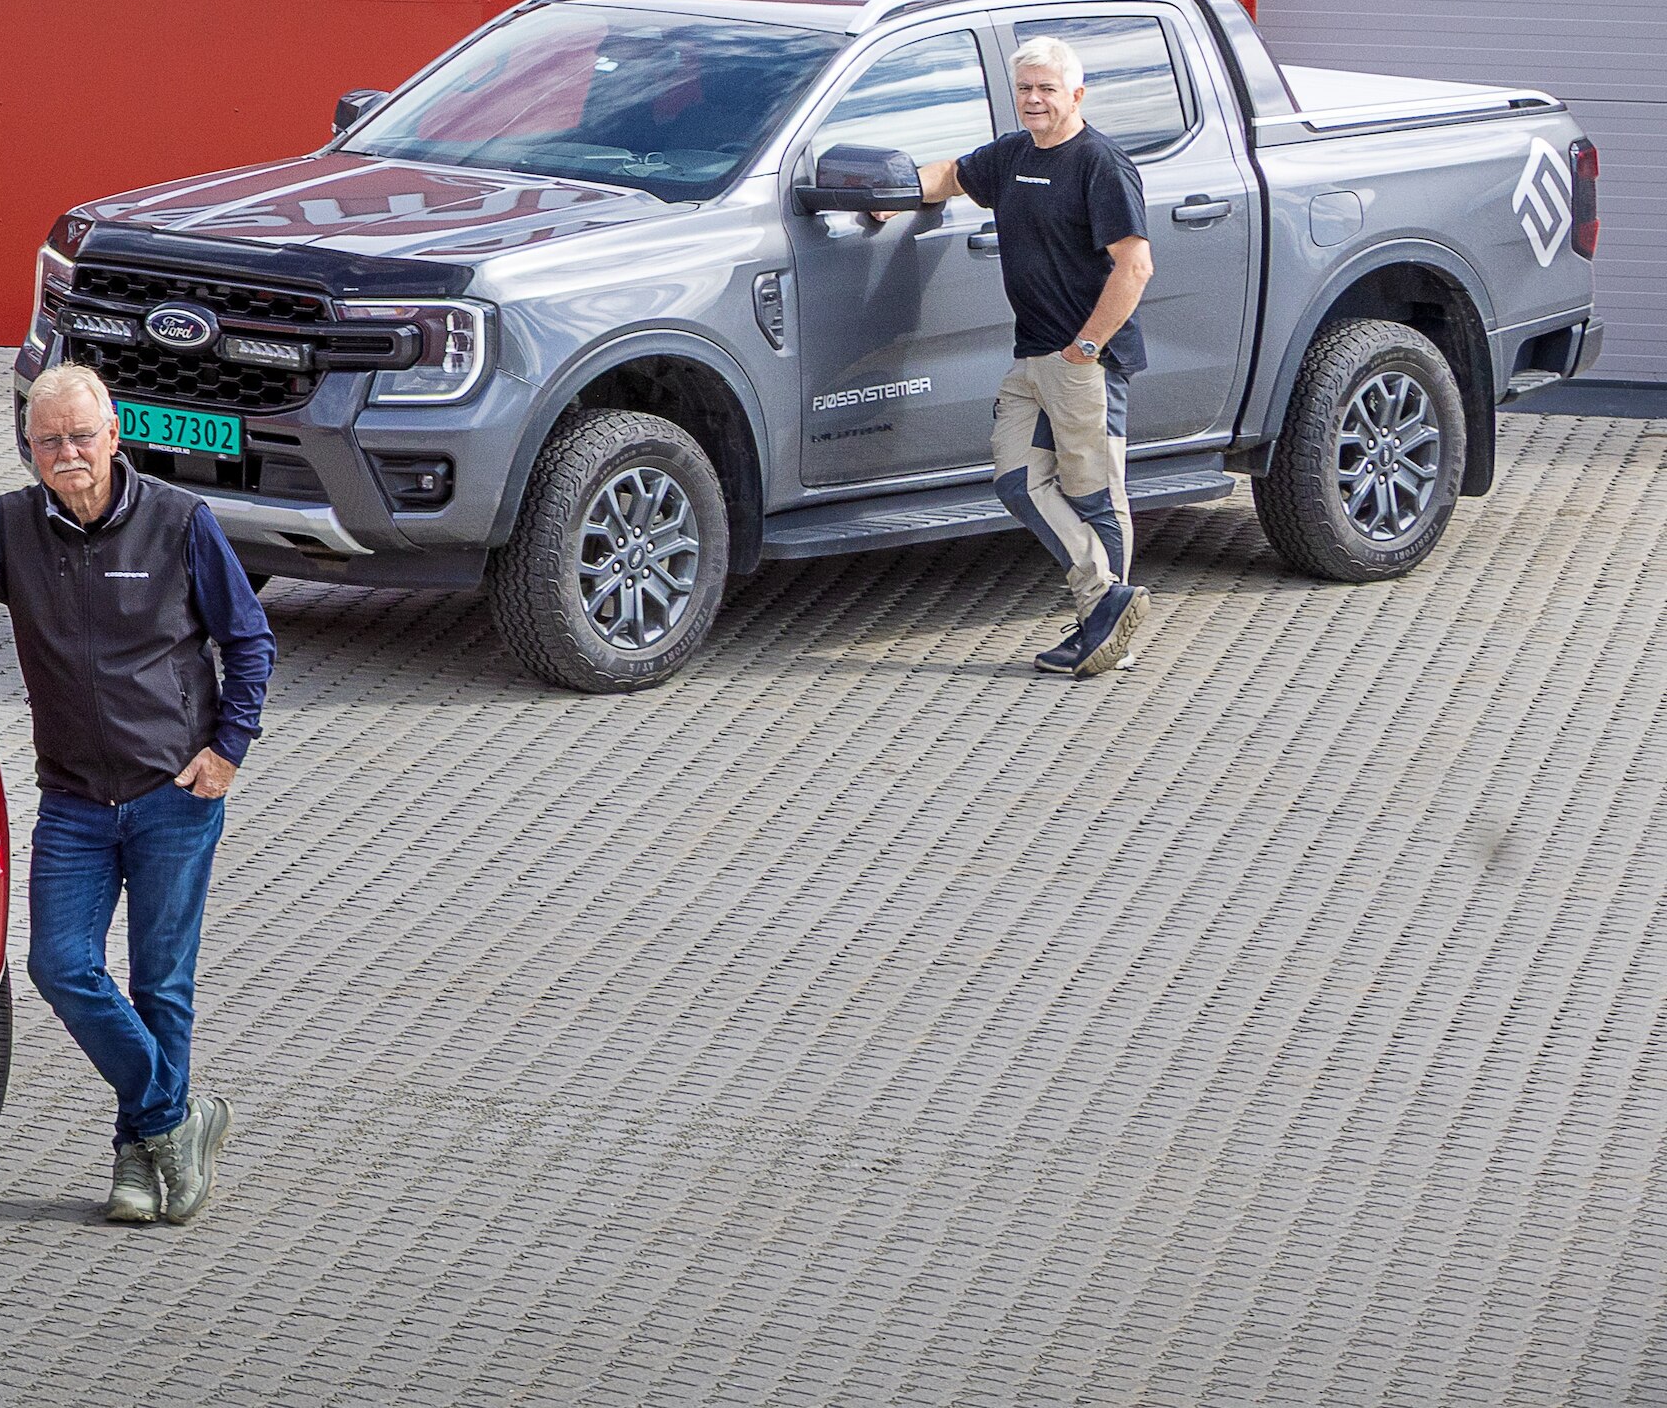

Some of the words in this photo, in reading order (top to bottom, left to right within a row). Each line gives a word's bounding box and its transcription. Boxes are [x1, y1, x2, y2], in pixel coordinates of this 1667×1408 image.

[158, 315, 194, 339] Ford
[812, 377, 932, 411] FJØSSYSTEMER
[123, 407, 151, 438] DS
[162, 413, 234, 450] 37302
